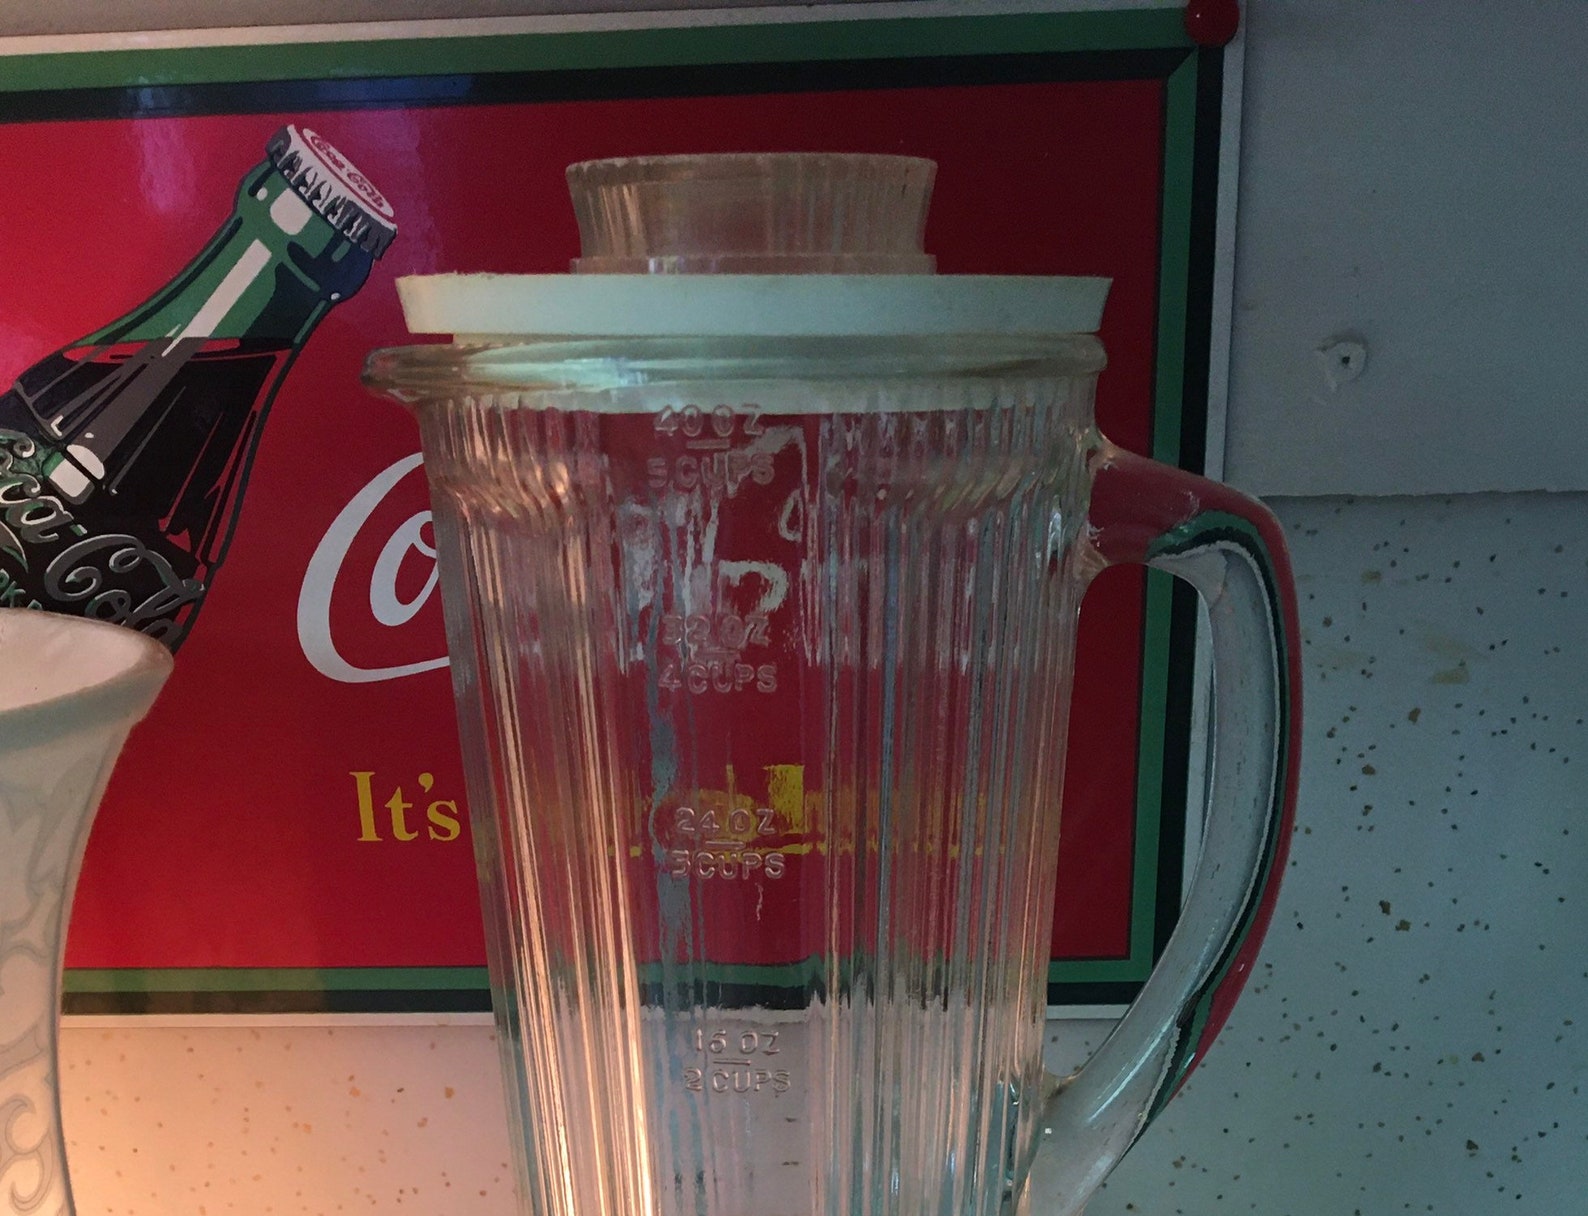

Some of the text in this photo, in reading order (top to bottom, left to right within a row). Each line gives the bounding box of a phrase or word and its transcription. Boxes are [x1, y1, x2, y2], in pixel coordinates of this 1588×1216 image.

[687, 663, 778, 694] CUPS
[349, 771, 461, 842] It's
[675, 806, 777, 835] 24 OZ
[698, 852, 786, 880] CUPS
[740, 1031, 780, 1055] OZ
[712, 1070, 791, 1094] CUPS
